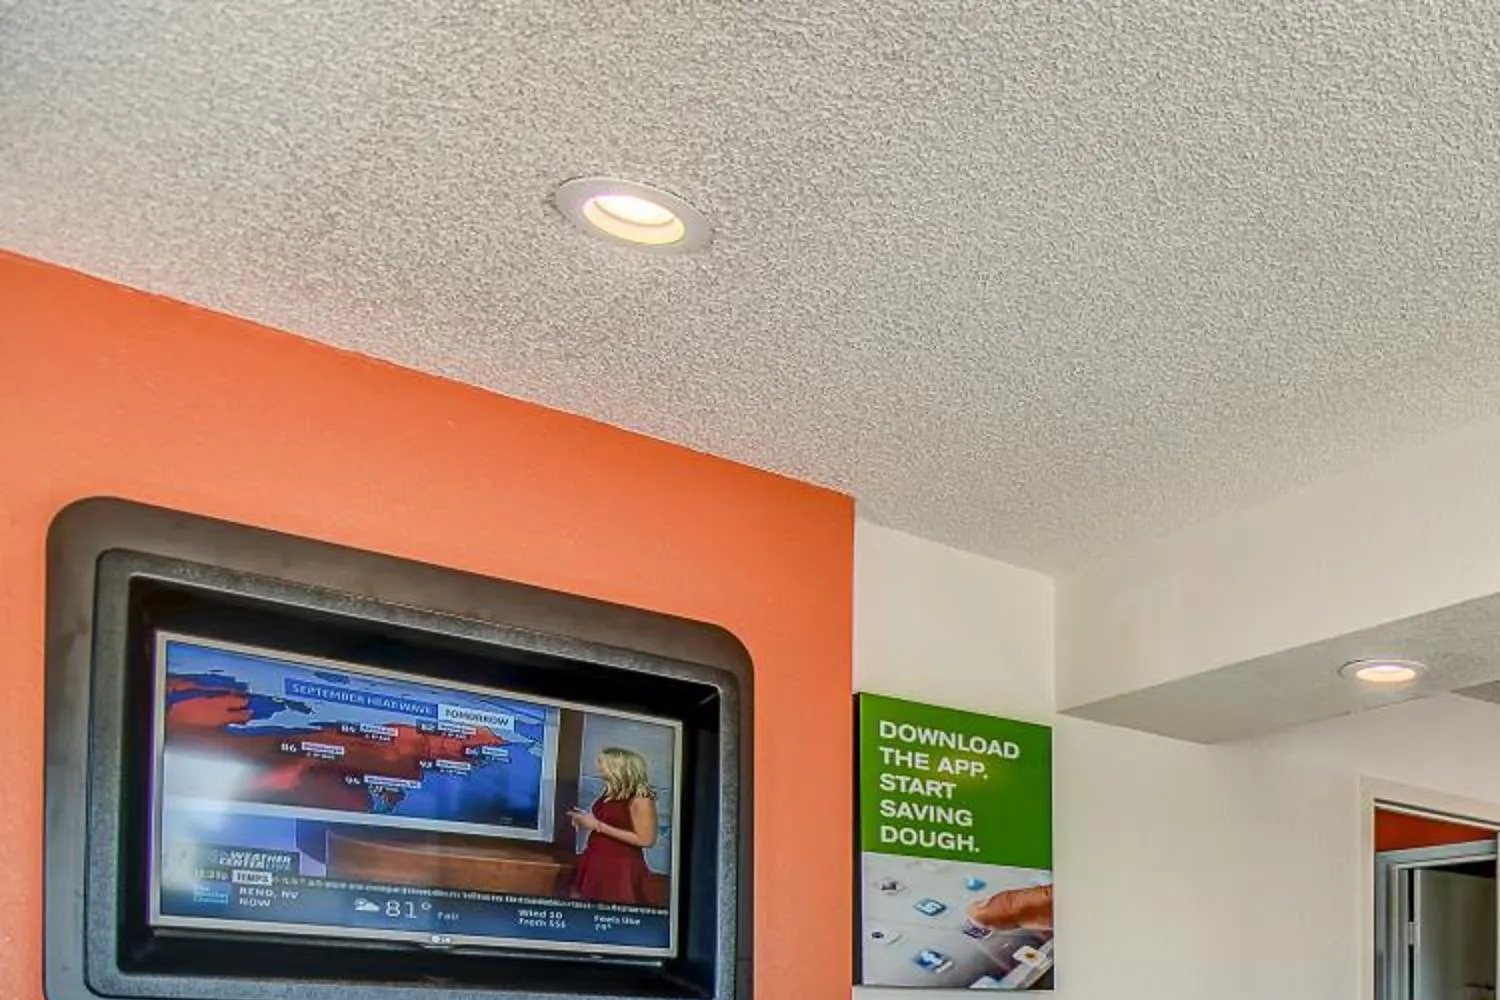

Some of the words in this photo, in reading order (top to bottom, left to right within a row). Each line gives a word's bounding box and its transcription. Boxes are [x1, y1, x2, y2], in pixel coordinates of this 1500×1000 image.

[445, 708, 509, 728] TOMORROW
[879, 720, 1020, 760] DOWNLOAD
[879, 747, 929, 771] THE
[938, 756, 988, 780] APP.
[880, 773, 956, 800] START
[880, 799, 973, 827] SAVING
[880, 825, 980, 852] DOUGH.
